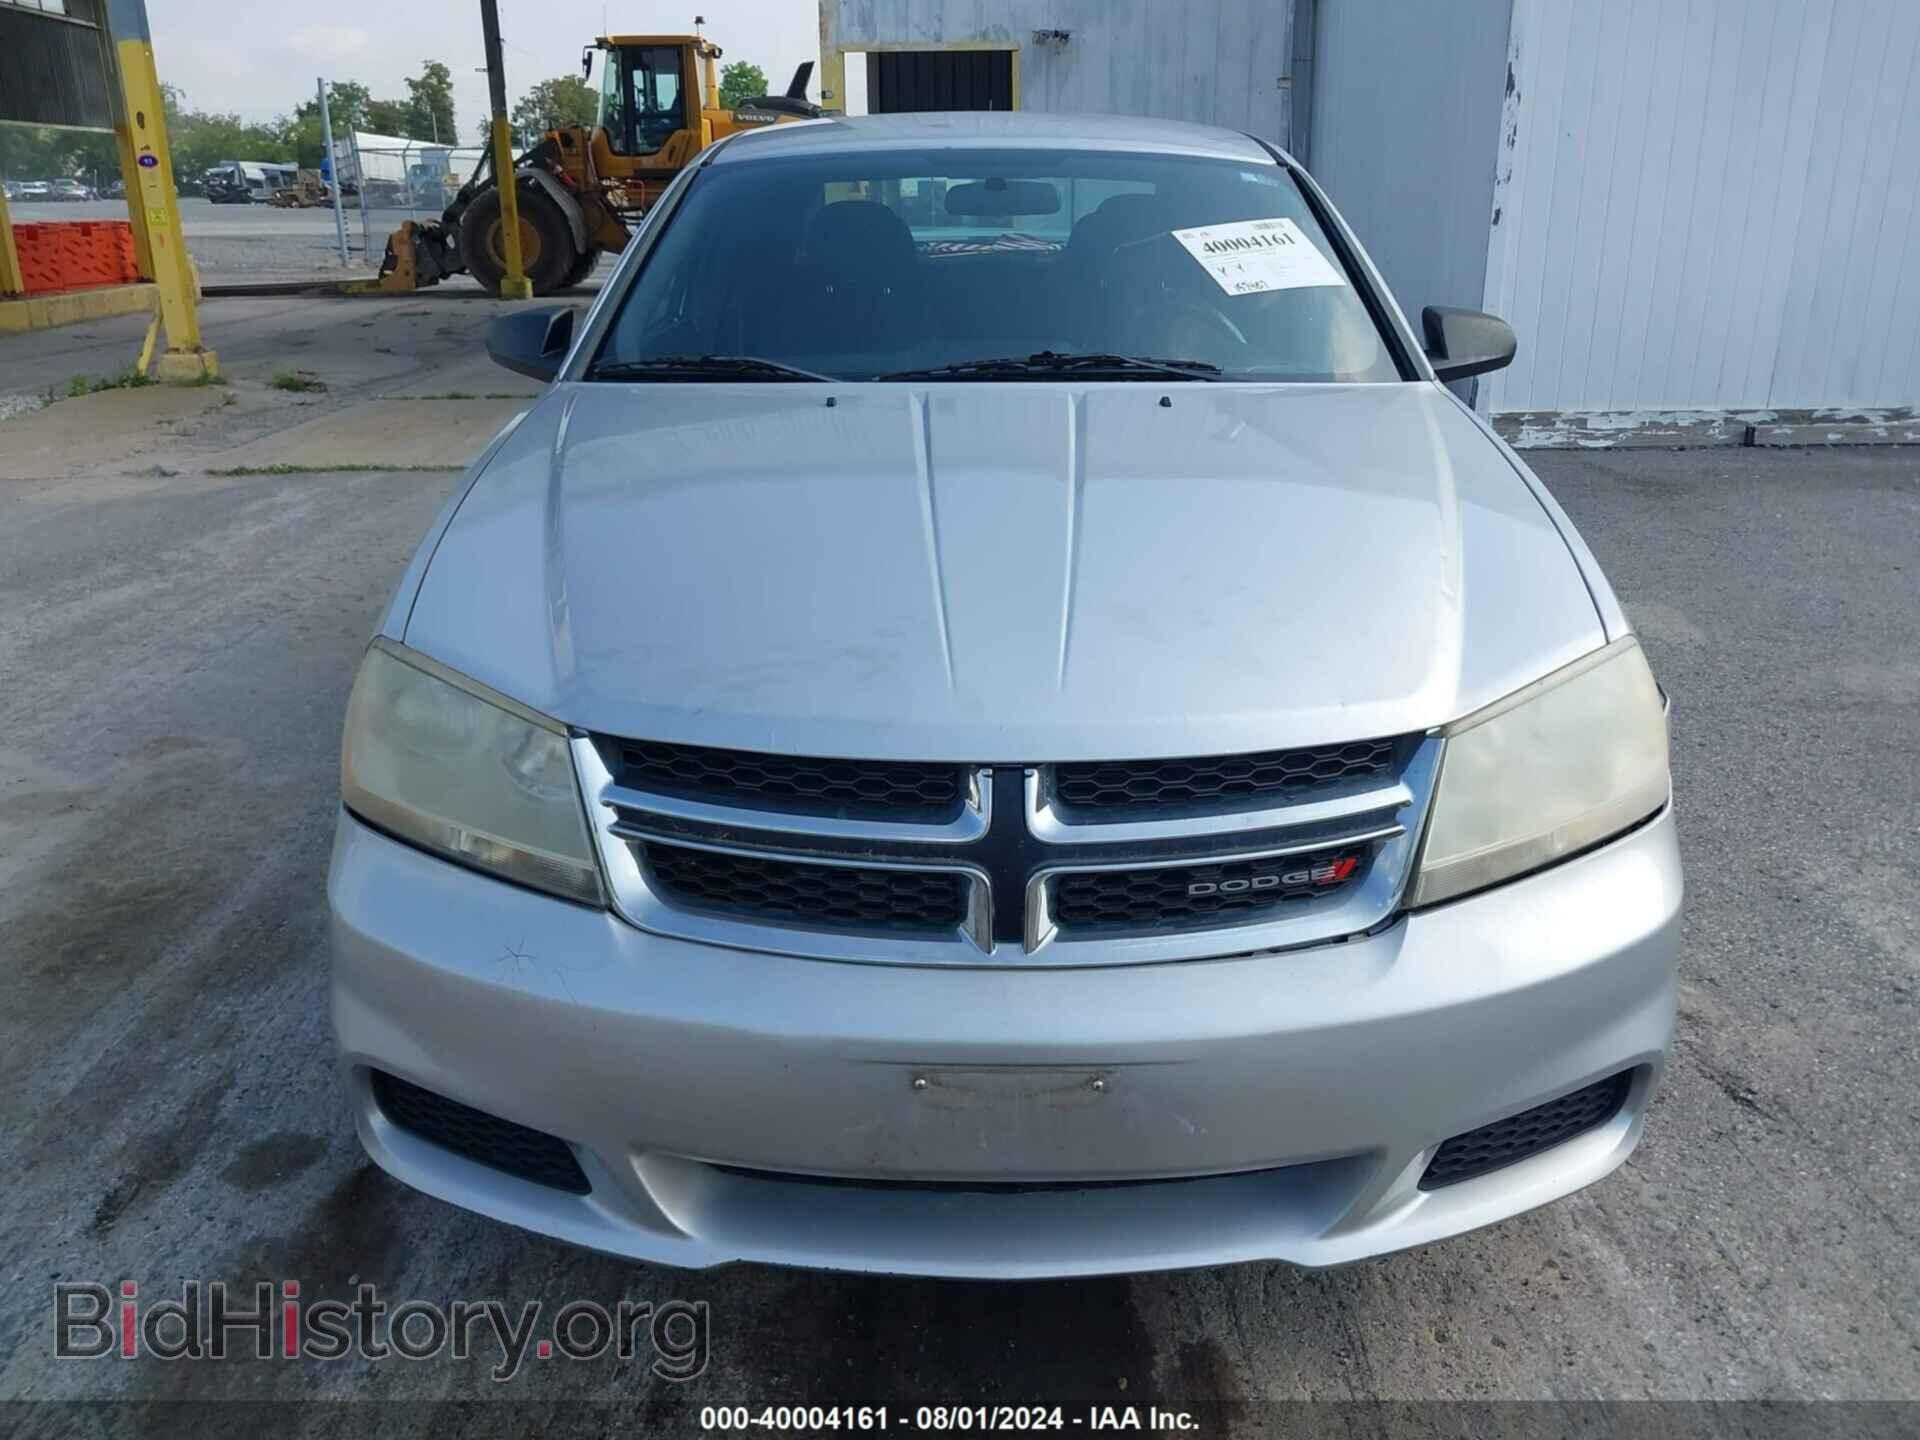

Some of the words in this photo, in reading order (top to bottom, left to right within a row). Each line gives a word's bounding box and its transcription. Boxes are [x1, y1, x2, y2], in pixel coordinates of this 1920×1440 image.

[736, 113, 775, 122] VOLVO
[1202, 232, 1296, 254] 40004161
[1188, 866, 1336, 895] DODGE
